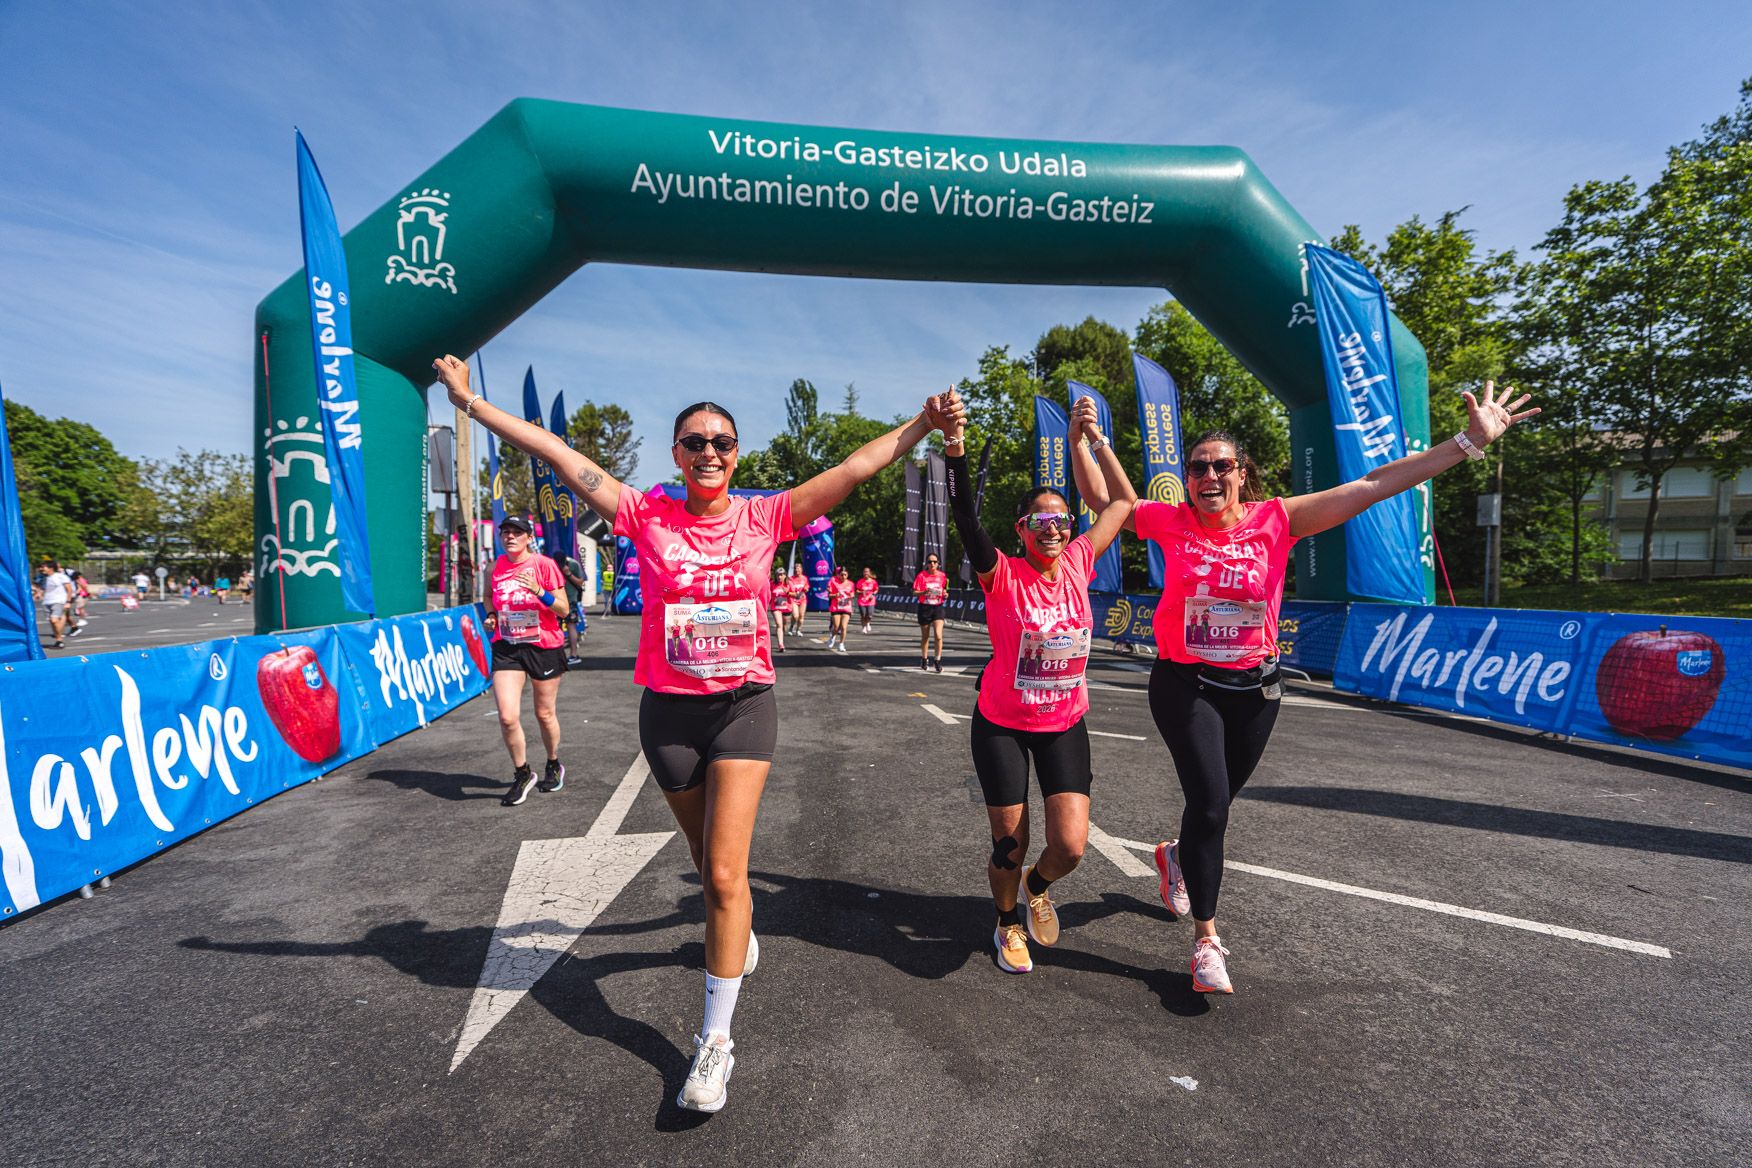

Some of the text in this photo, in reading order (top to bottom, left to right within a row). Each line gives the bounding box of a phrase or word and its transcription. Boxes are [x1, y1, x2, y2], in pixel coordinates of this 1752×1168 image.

[708, 129, 1088, 178] Vitoria-Gasteizko Udala
[630, 162, 1156, 225] Ayuntamiento de Vitoria-Gasteiz
[948, 468, 957, 497] KIPRUN
[695, 636, 729, 651] 016
[1209, 626, 1239, 638] 016
[368, 619, 470, 726] Marlene
[1041, 659, 1069, 670] 016
[1361, 611, 1572, 715] Marlene
[0, 664, 258, 913] arlene
